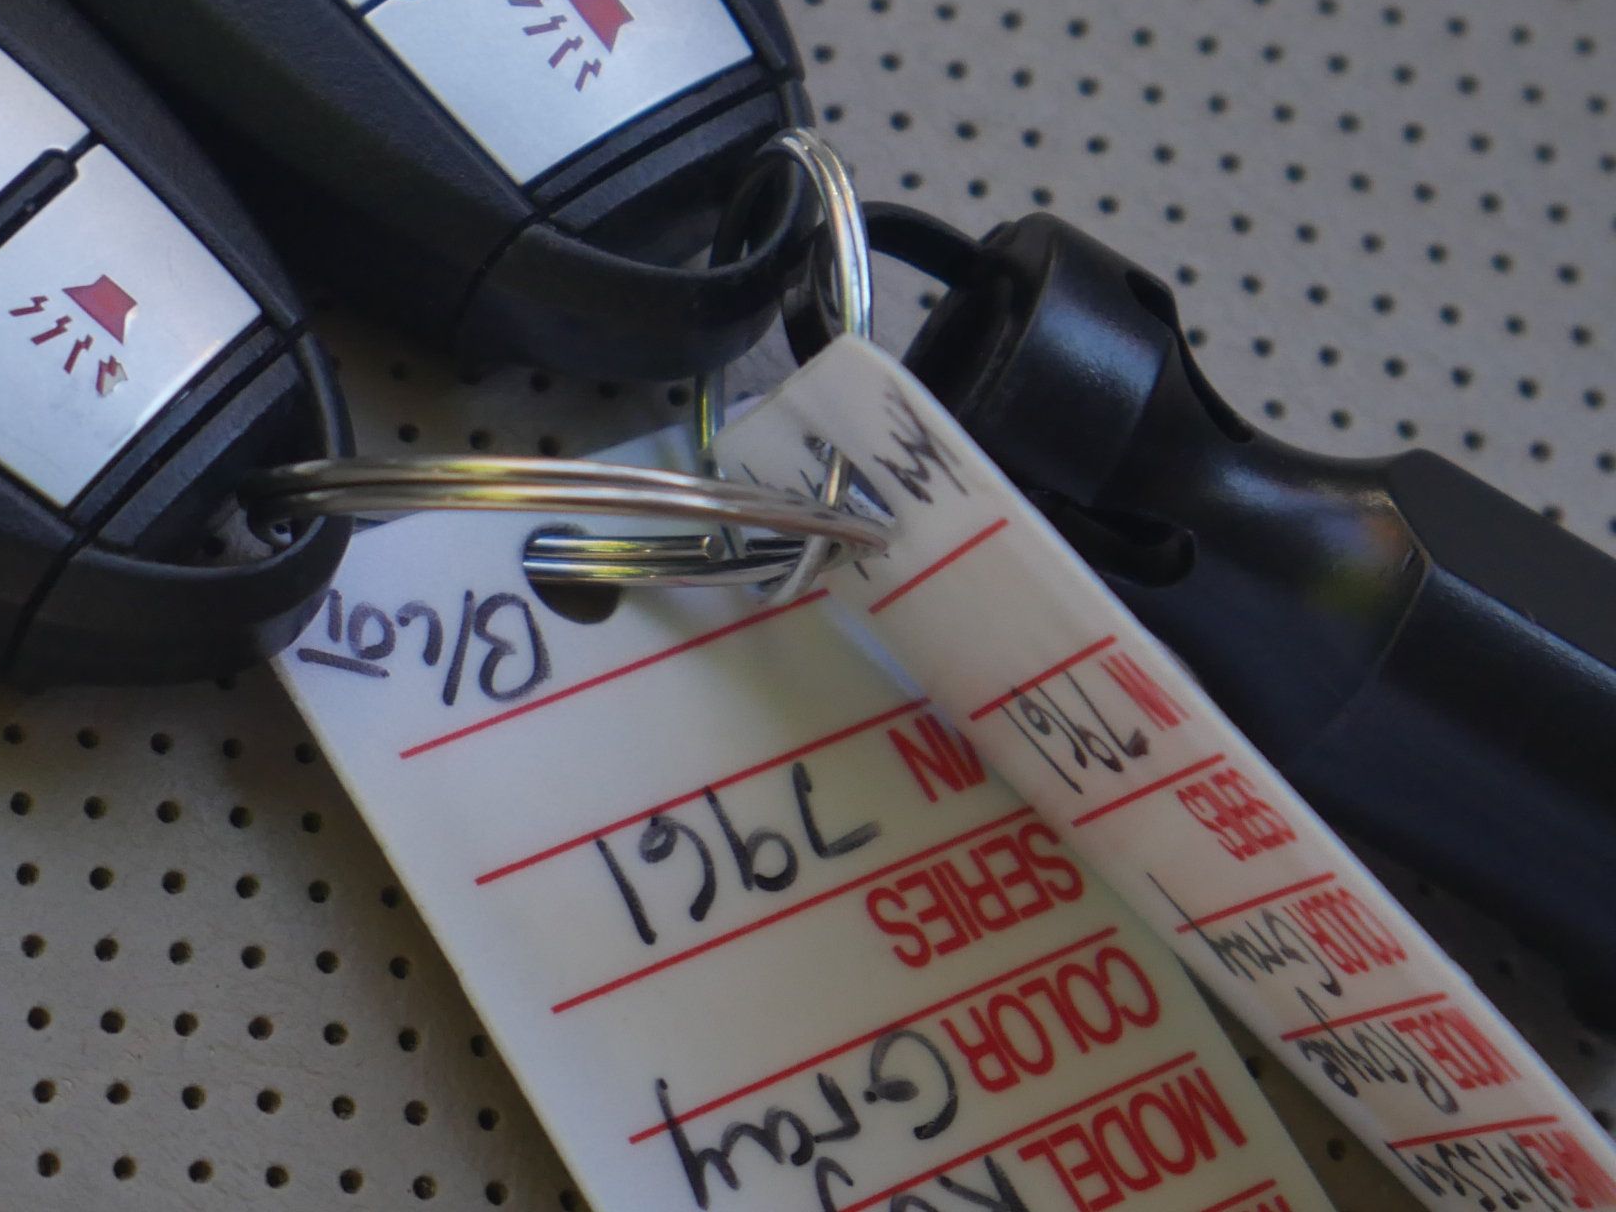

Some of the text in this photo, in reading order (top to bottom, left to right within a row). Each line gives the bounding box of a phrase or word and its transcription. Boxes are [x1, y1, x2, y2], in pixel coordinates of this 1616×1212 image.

[997, 668, 1150, 795] 7961
[595, 759, 882, 946] 7961
[1177, 766, 1297, 861] SERIES
[865, 820, 1085, 968] SERIES
[1282, 885, 1408, 975] COLOR
[940, 945, 1161, 1092] COLOR
[656, 1029, 959, 1210] Gray
[1018, 1066, 1247, 1212] MODEL
